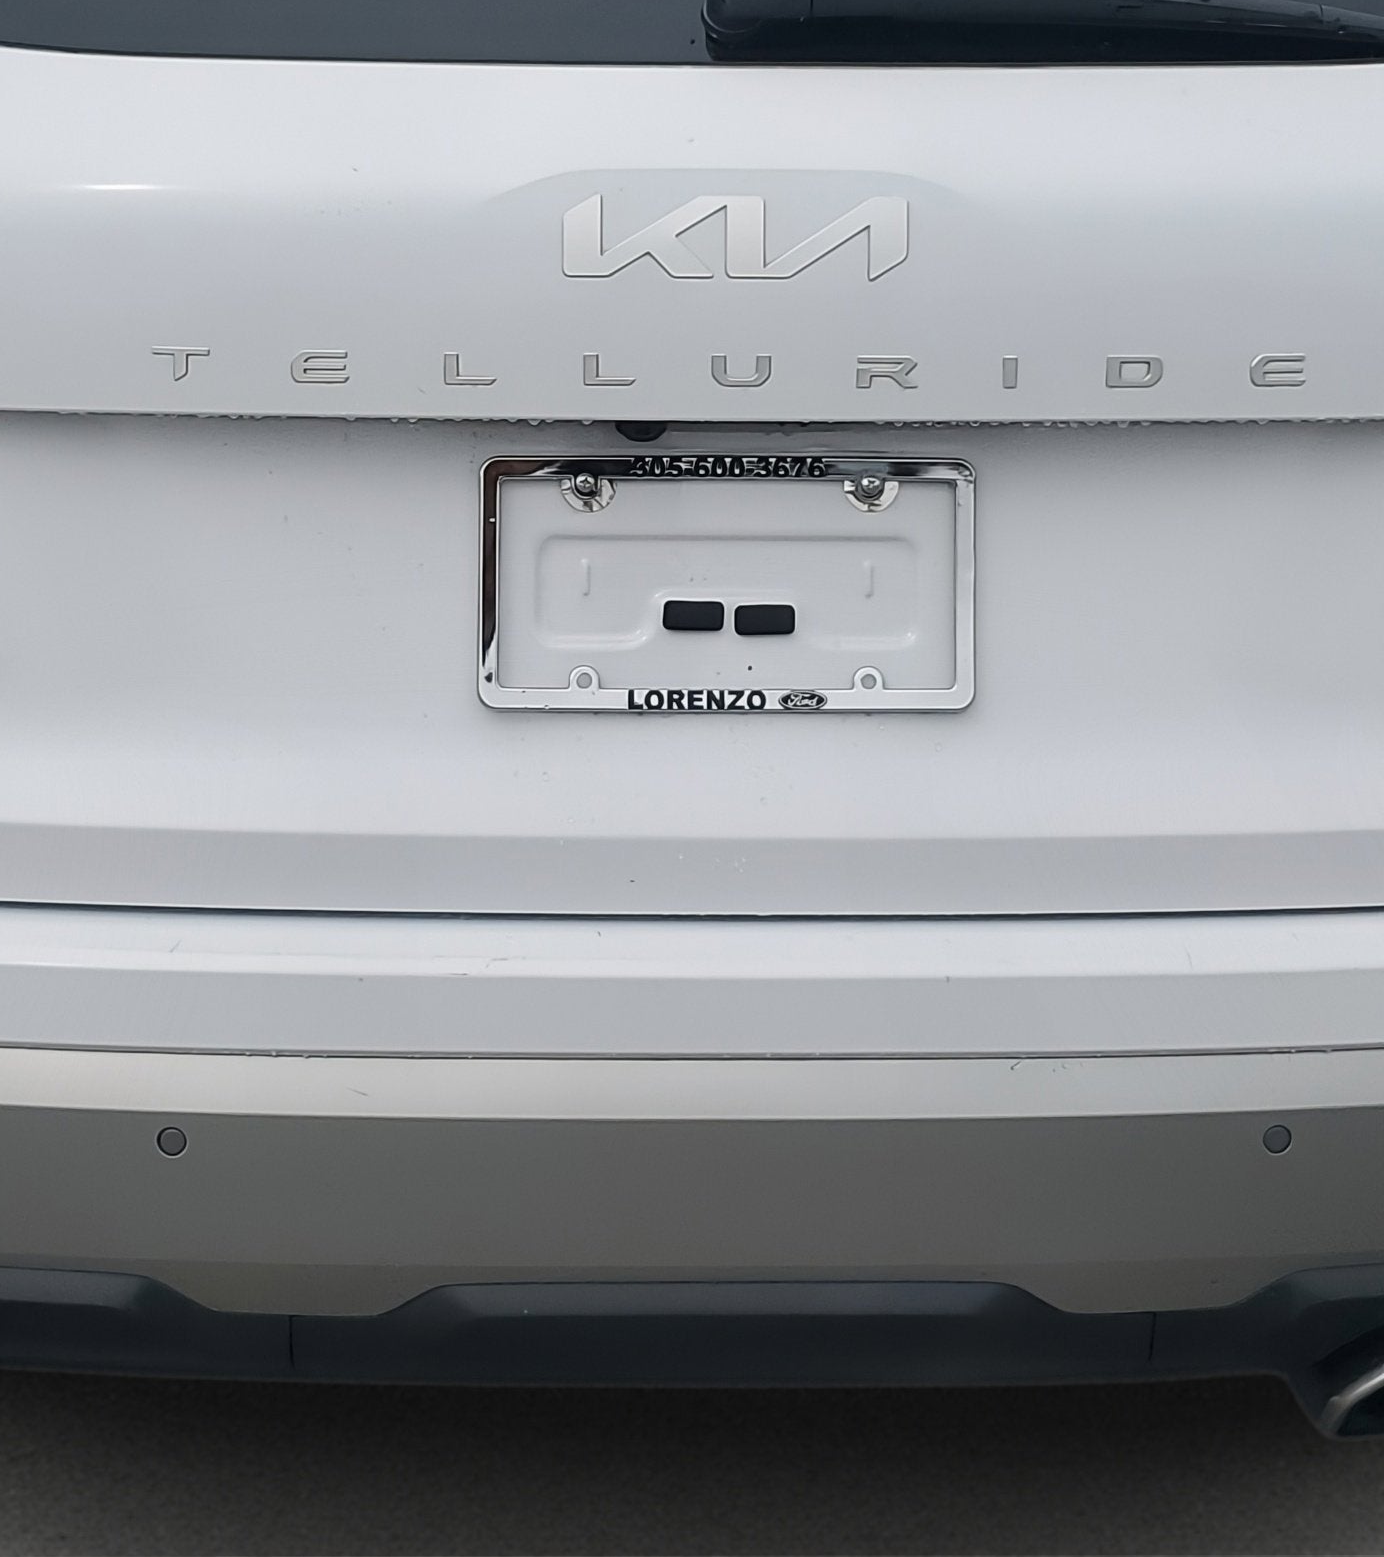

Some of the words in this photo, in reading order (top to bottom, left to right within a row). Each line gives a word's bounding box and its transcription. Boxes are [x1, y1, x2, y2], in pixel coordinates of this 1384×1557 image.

[561, 194, 909, 282] KIA
[151, 346, 1308, 389] TELLURIDE
[627, 689, 767, 710] LORENZO
